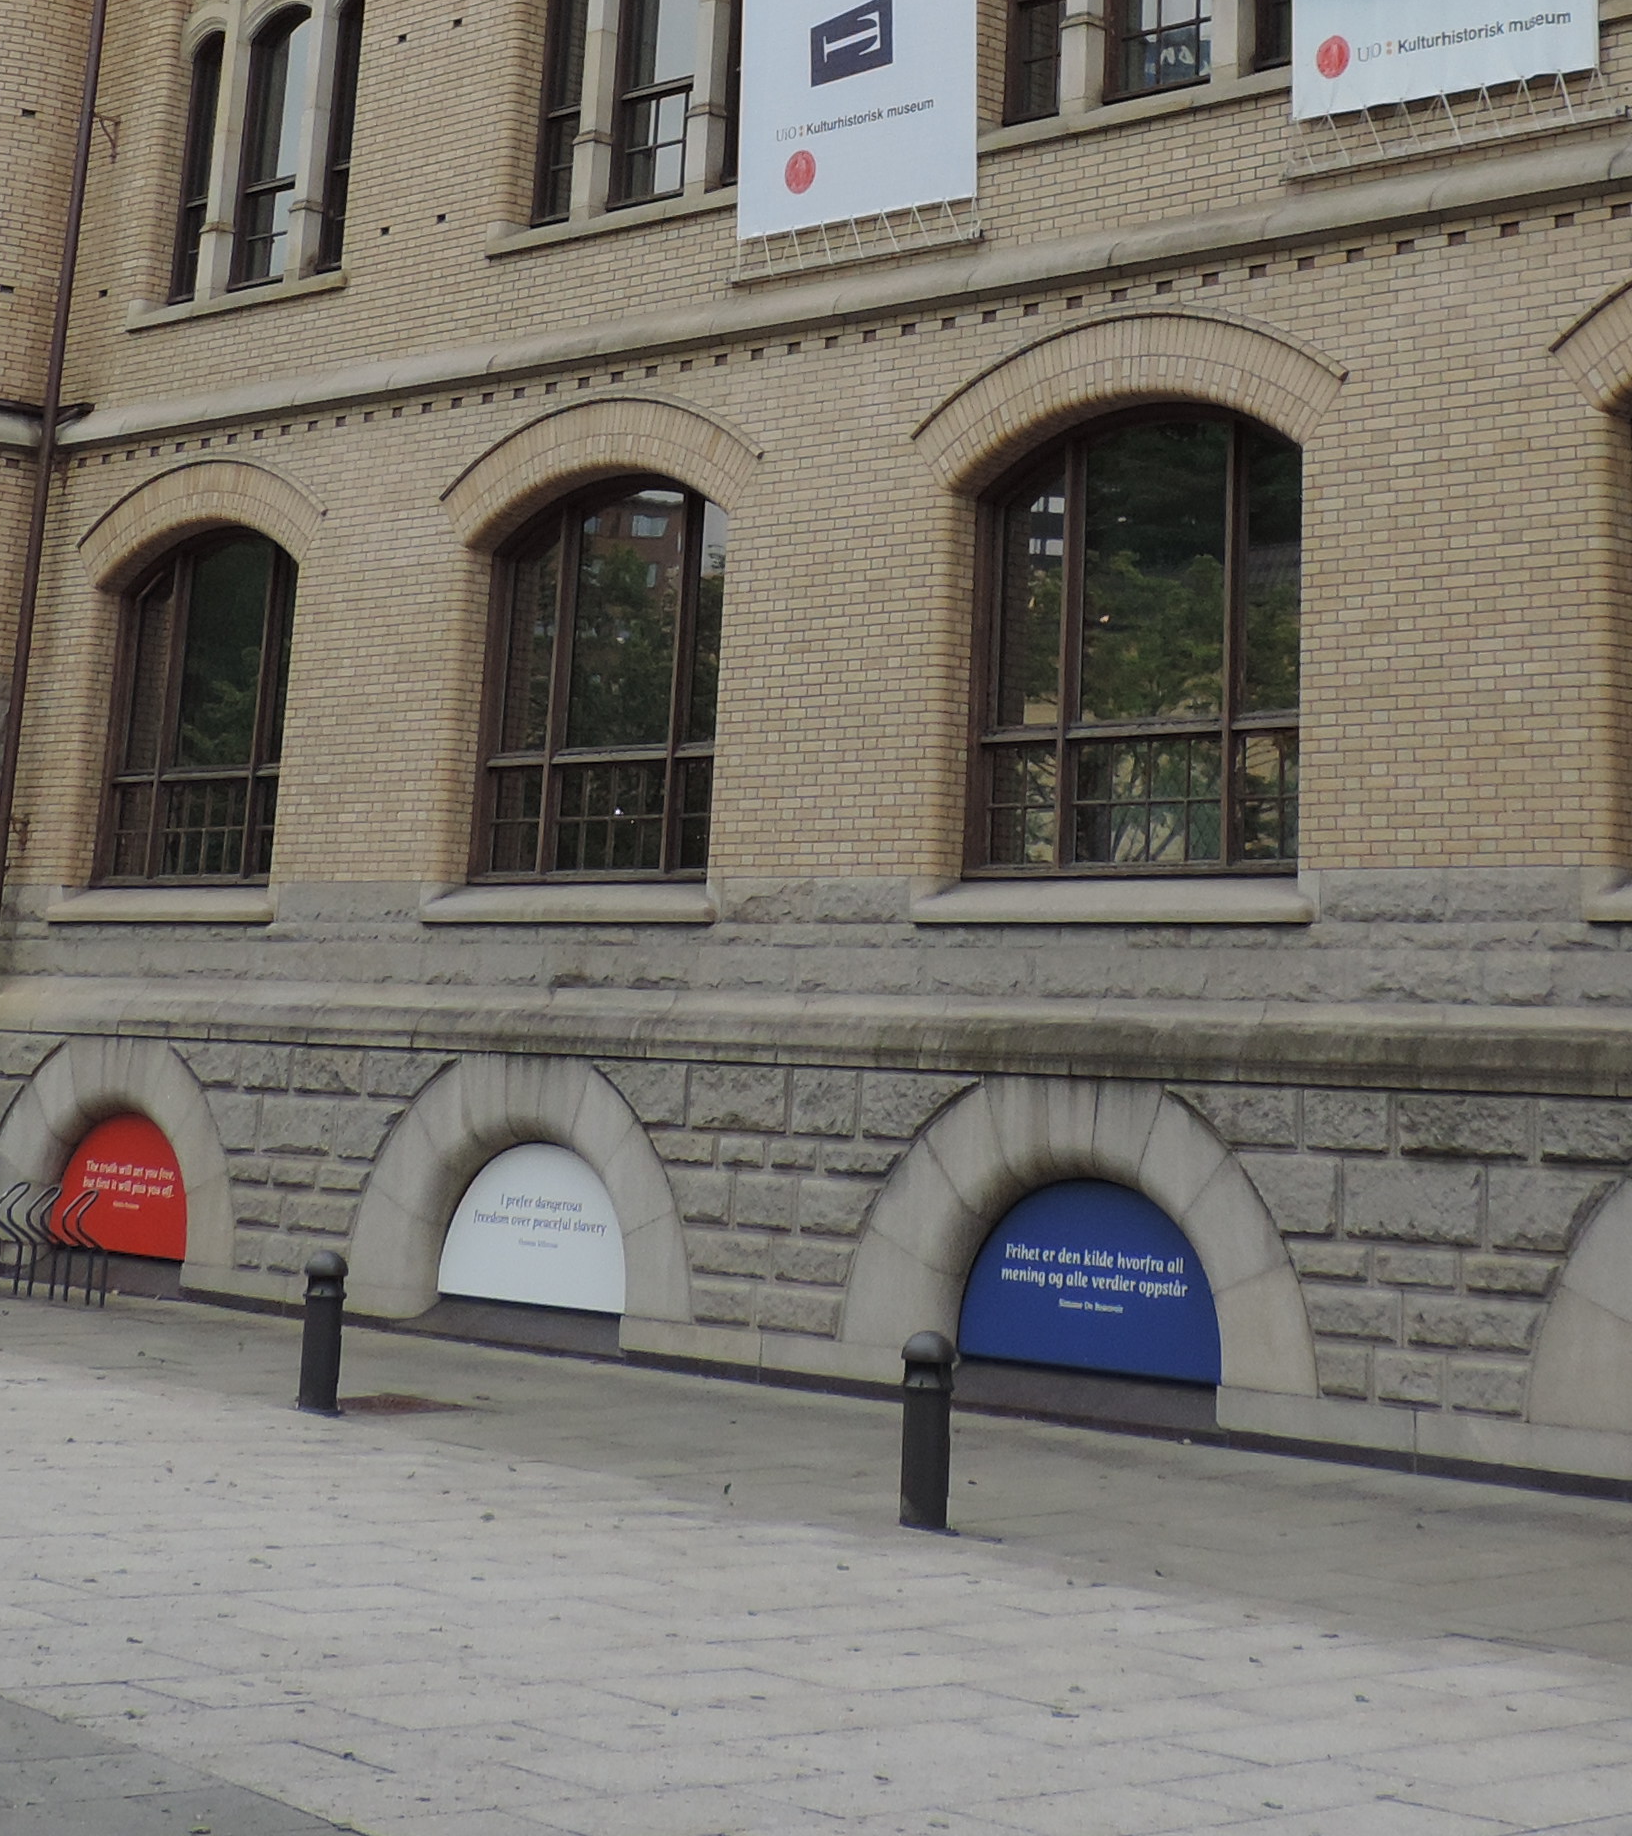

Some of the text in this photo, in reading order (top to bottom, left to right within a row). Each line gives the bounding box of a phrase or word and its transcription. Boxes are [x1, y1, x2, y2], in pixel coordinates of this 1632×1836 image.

[1398, 21, 1505, 54] Kulturhistorisk
[1508, 12, 1572, 33] museum
[806, 108, 883, 136] Kulturhistorisk
[887, 98, 934, 117] museum
[86, 1160, 99, 1173] The
[119, 1164, 132, 1175] will
[145, 1168, 158, 1180] you
[118, 1180, 132, 1192] will
[147, 1185, 161, 1198] you
[500, 1194, 583, 1213] I prefer dangerous
[473, 1209, 608, 1237] freedom over peaceful slavery
[1005, 1243, 1184, 1274] Frihet er den kilde hvorfra all
[1001, 1266, 1188, 1299] mening og alle verdier oppstår
